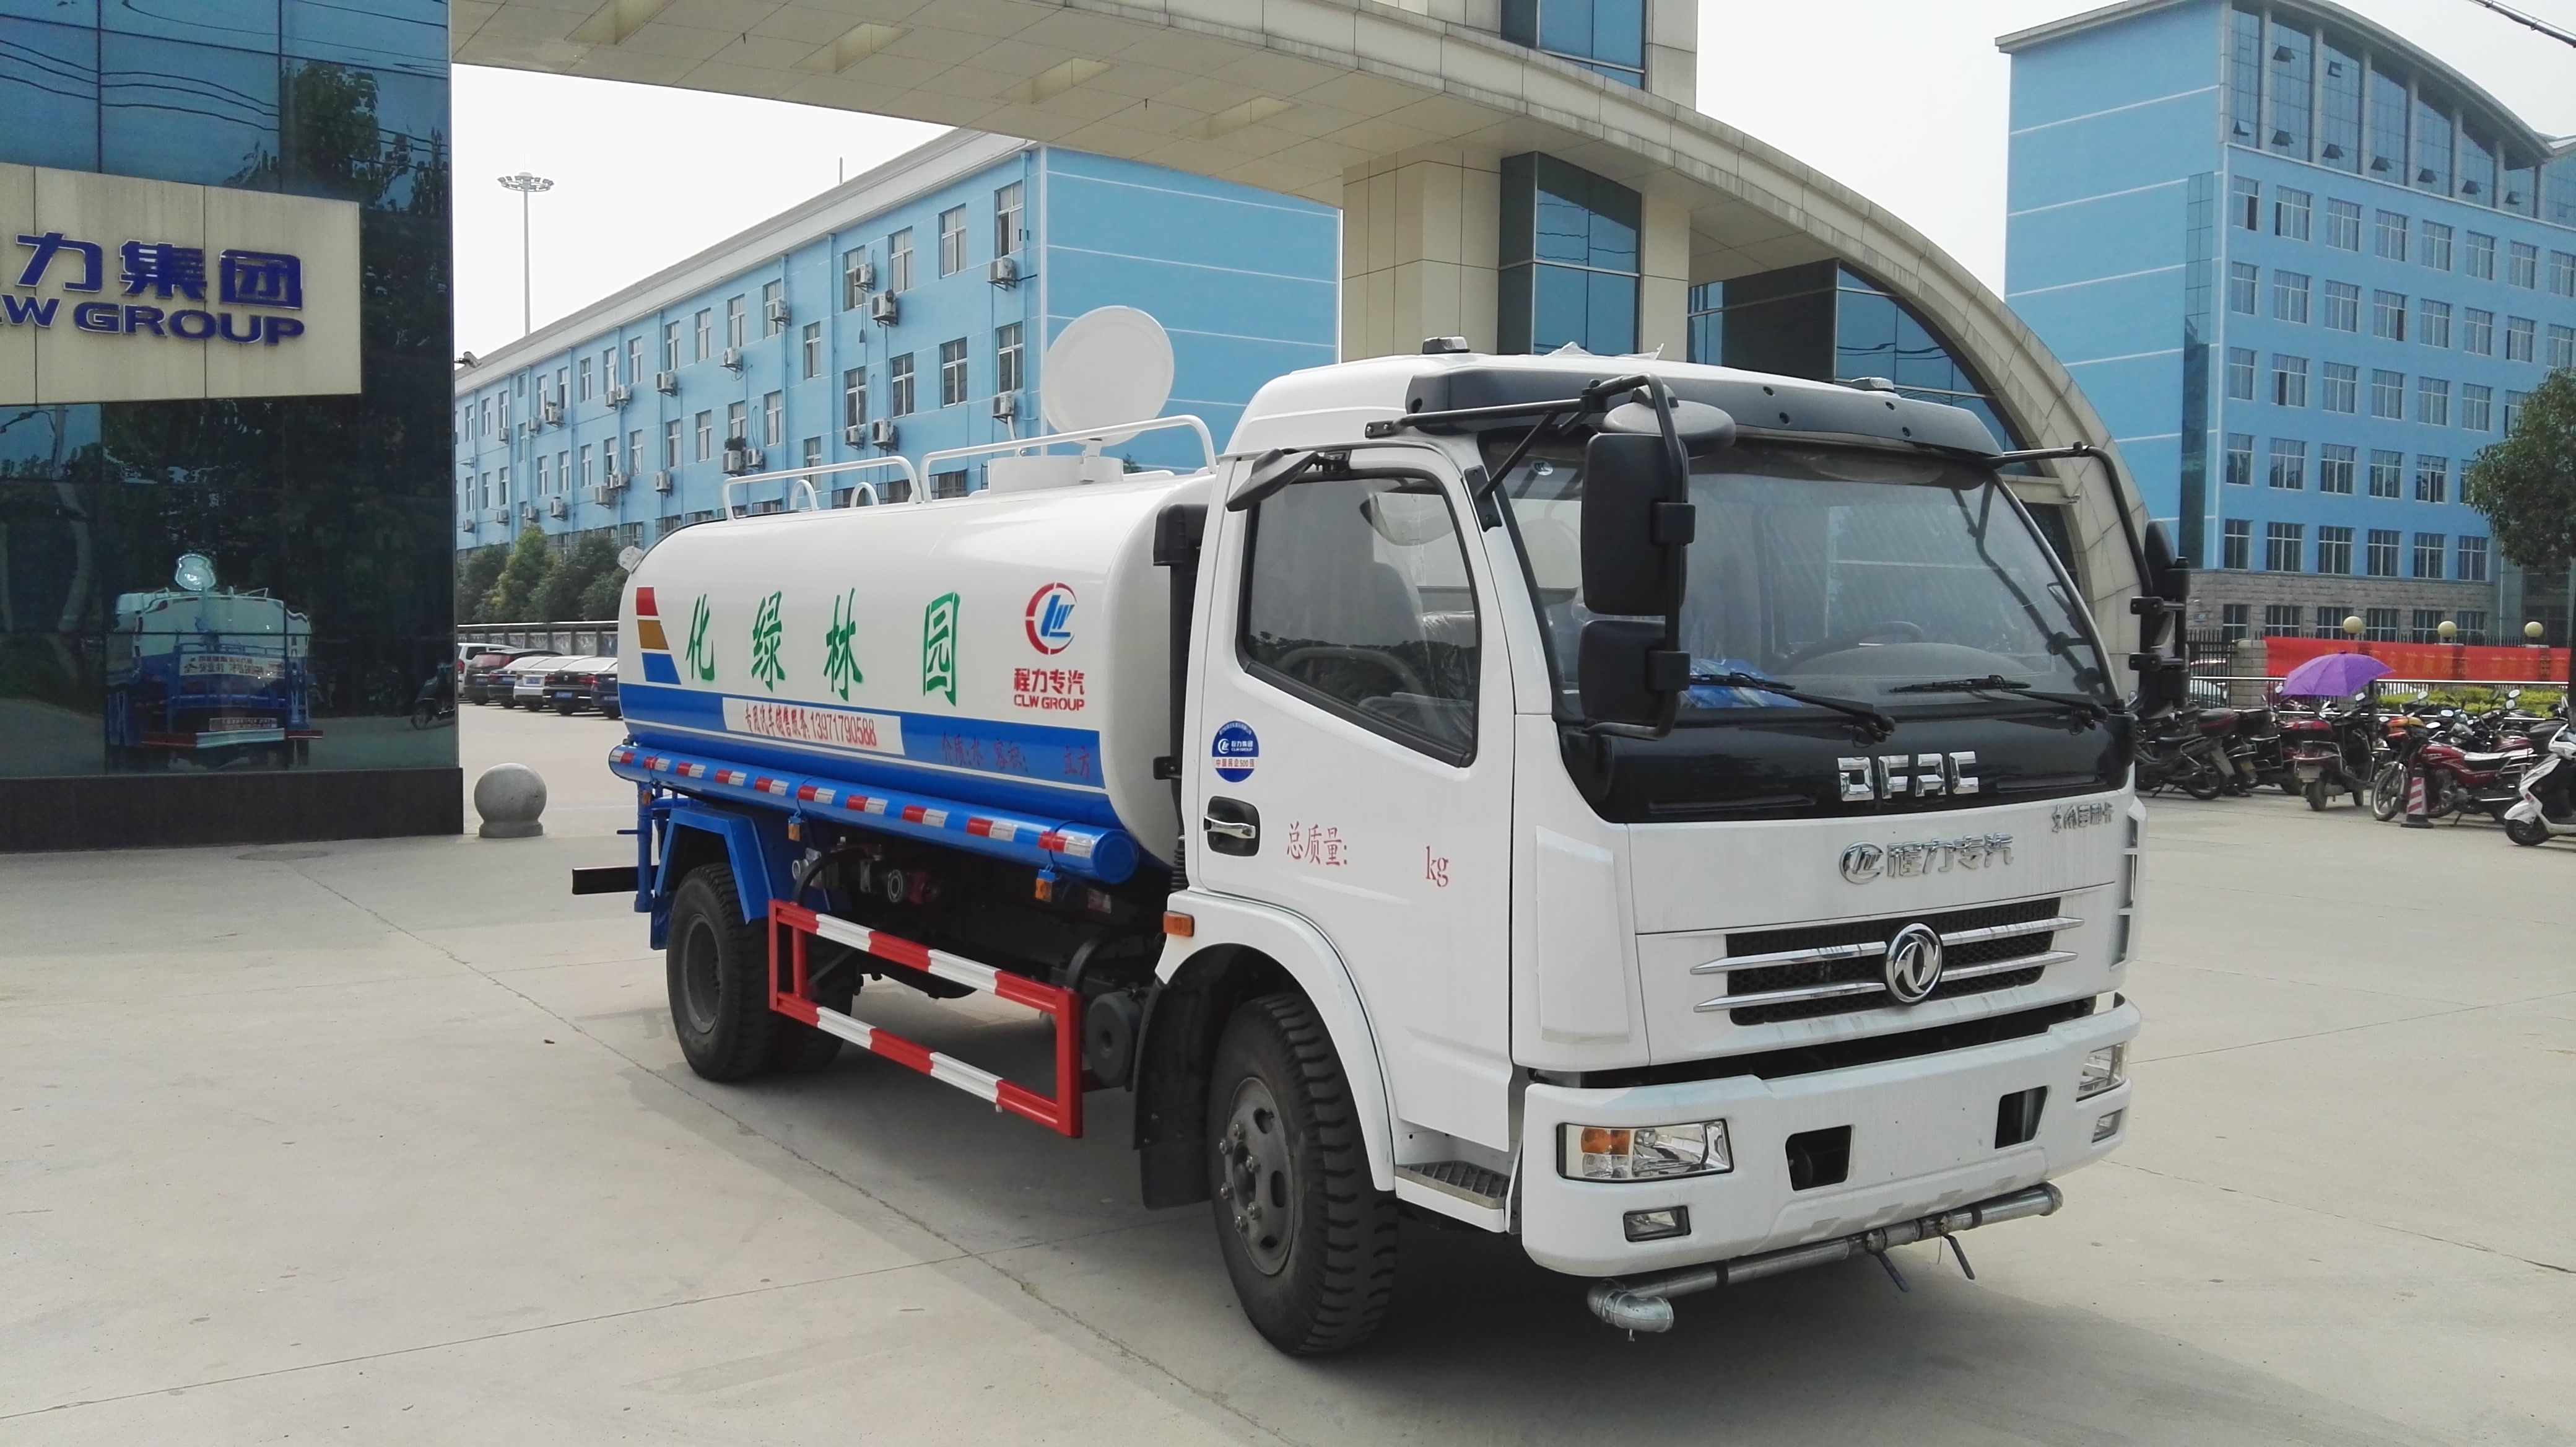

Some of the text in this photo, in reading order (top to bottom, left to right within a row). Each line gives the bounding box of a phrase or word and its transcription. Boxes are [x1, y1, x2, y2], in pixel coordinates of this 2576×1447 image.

[15, 231, 303, 310] 力集团
[0, 293, 305, 346] W GROUP
[1014, 668, 1085, 695] 程力专汽
[1014, 694, 1085, 711] CLW GROUP
[1837, 751, 1979, 802] DFAC
[1286, 821, 1450, 887] 总质量: kg
[1887, 833, 2014, 877] 程力专汽
